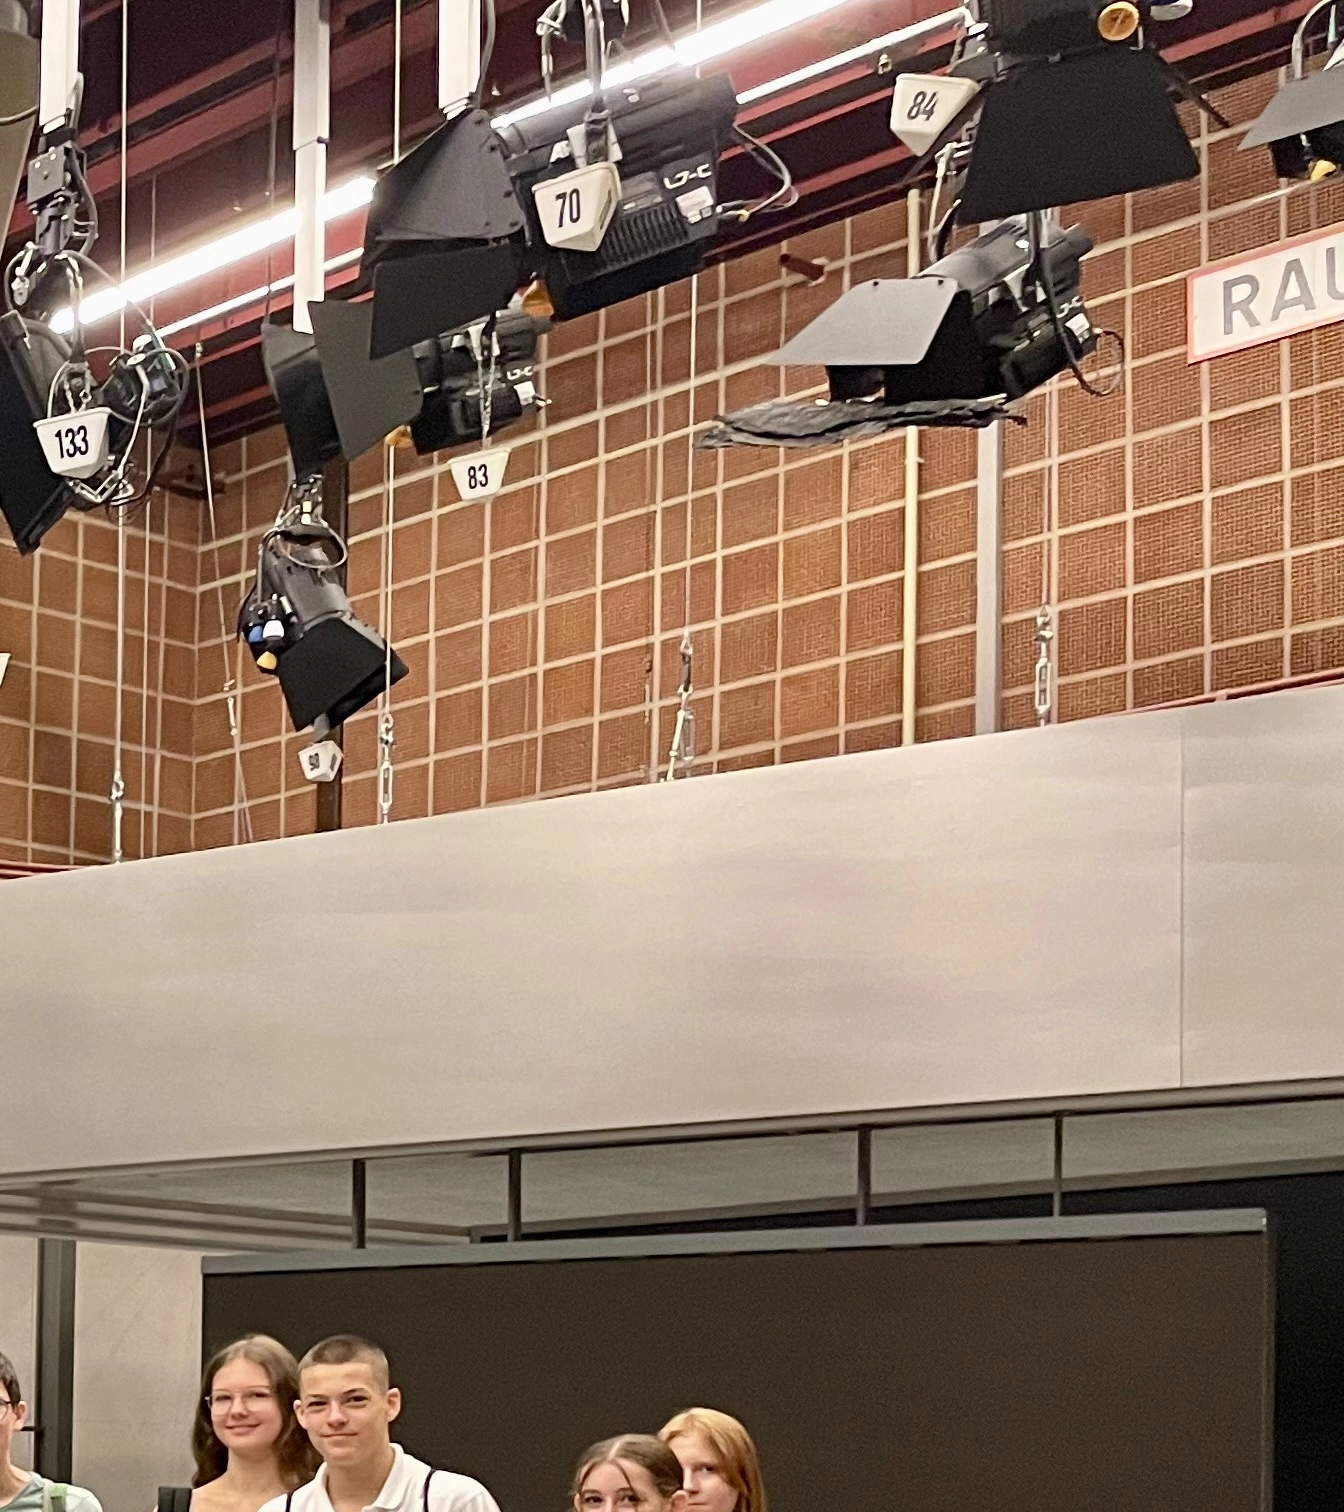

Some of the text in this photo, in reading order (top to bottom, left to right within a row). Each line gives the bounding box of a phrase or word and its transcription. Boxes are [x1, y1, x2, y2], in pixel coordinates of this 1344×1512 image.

[907, 91, 938, 121] 84
[555, 188, 581, 228] 70
[54, 425, 88, 459] 133
[468, 464, 488, 489] 83
